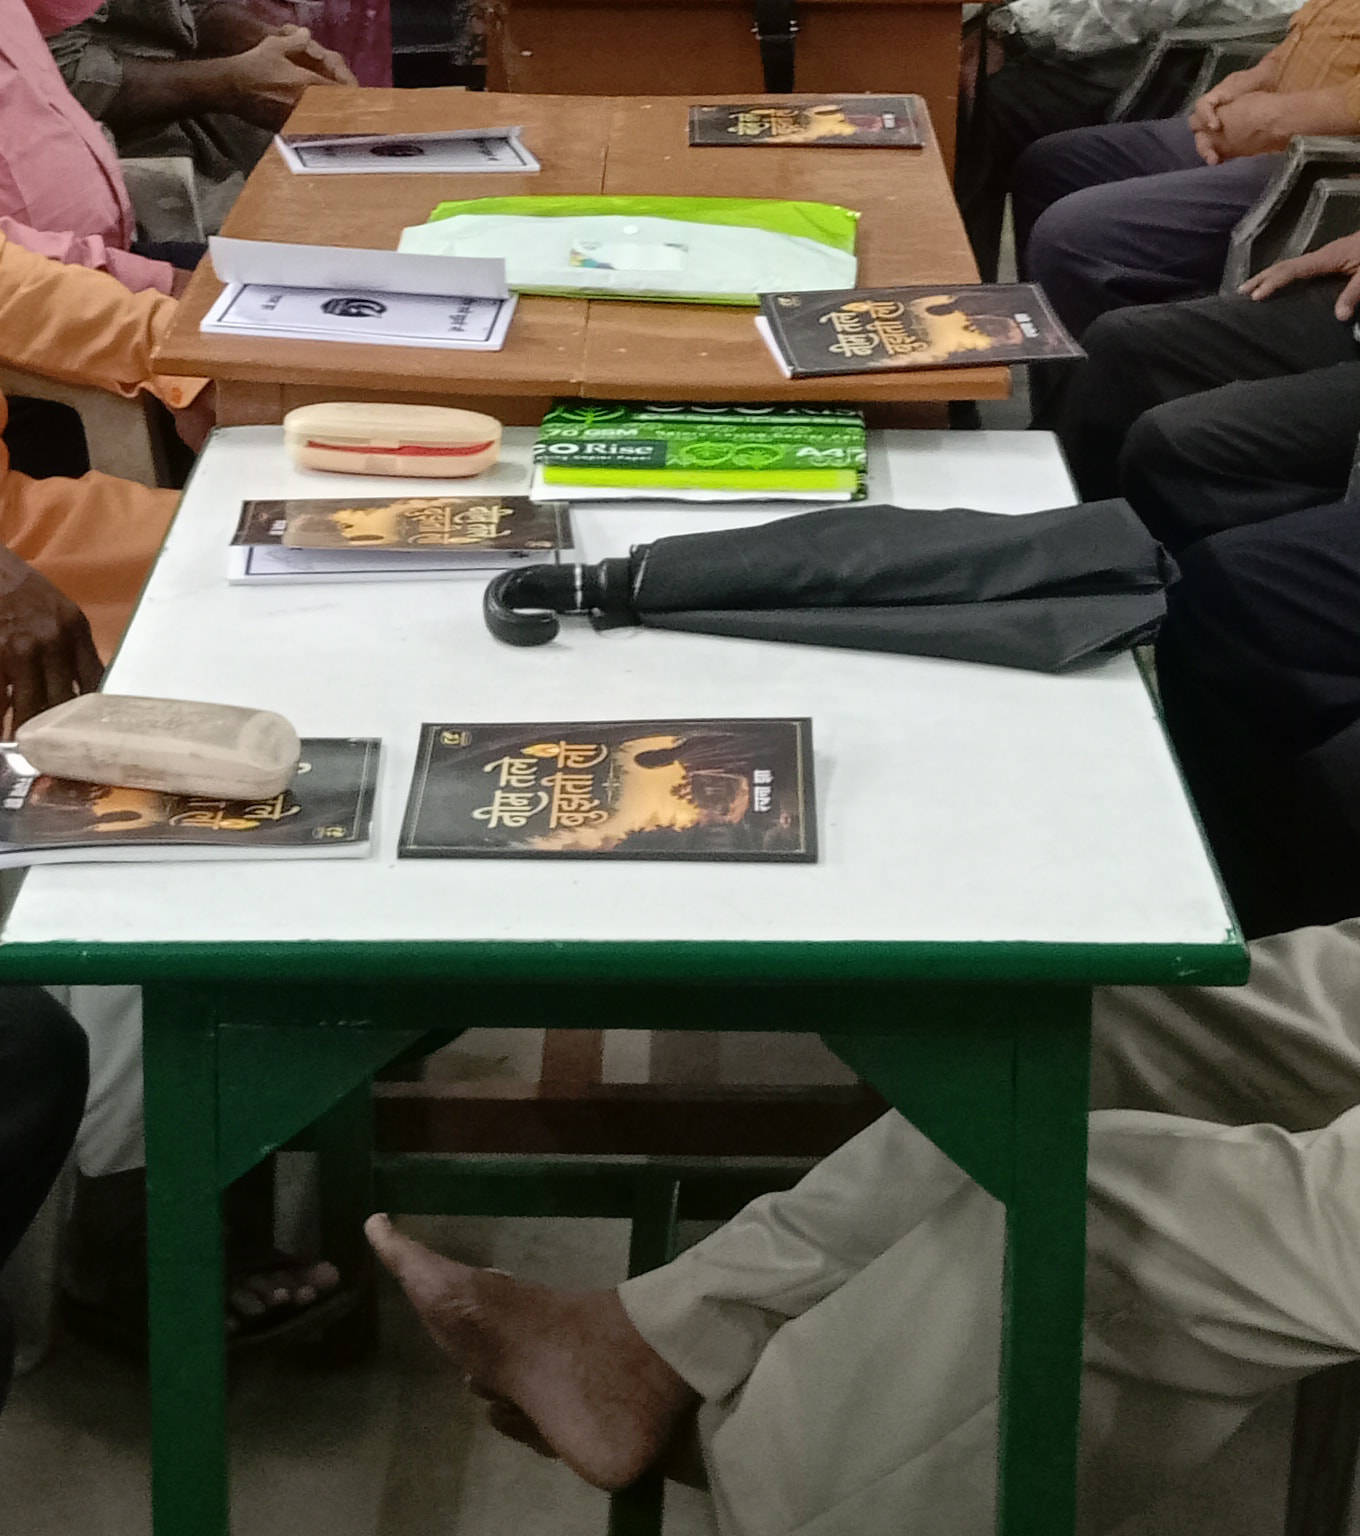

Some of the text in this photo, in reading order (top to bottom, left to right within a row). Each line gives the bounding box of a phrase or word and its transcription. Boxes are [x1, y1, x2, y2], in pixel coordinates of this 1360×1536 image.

[583, 442, 654, 455] Rise
[584, 428, 639, 437] GSM
[471, 754, 549, 830] नीम तले
[541, 771, 610, 830] बुझती
